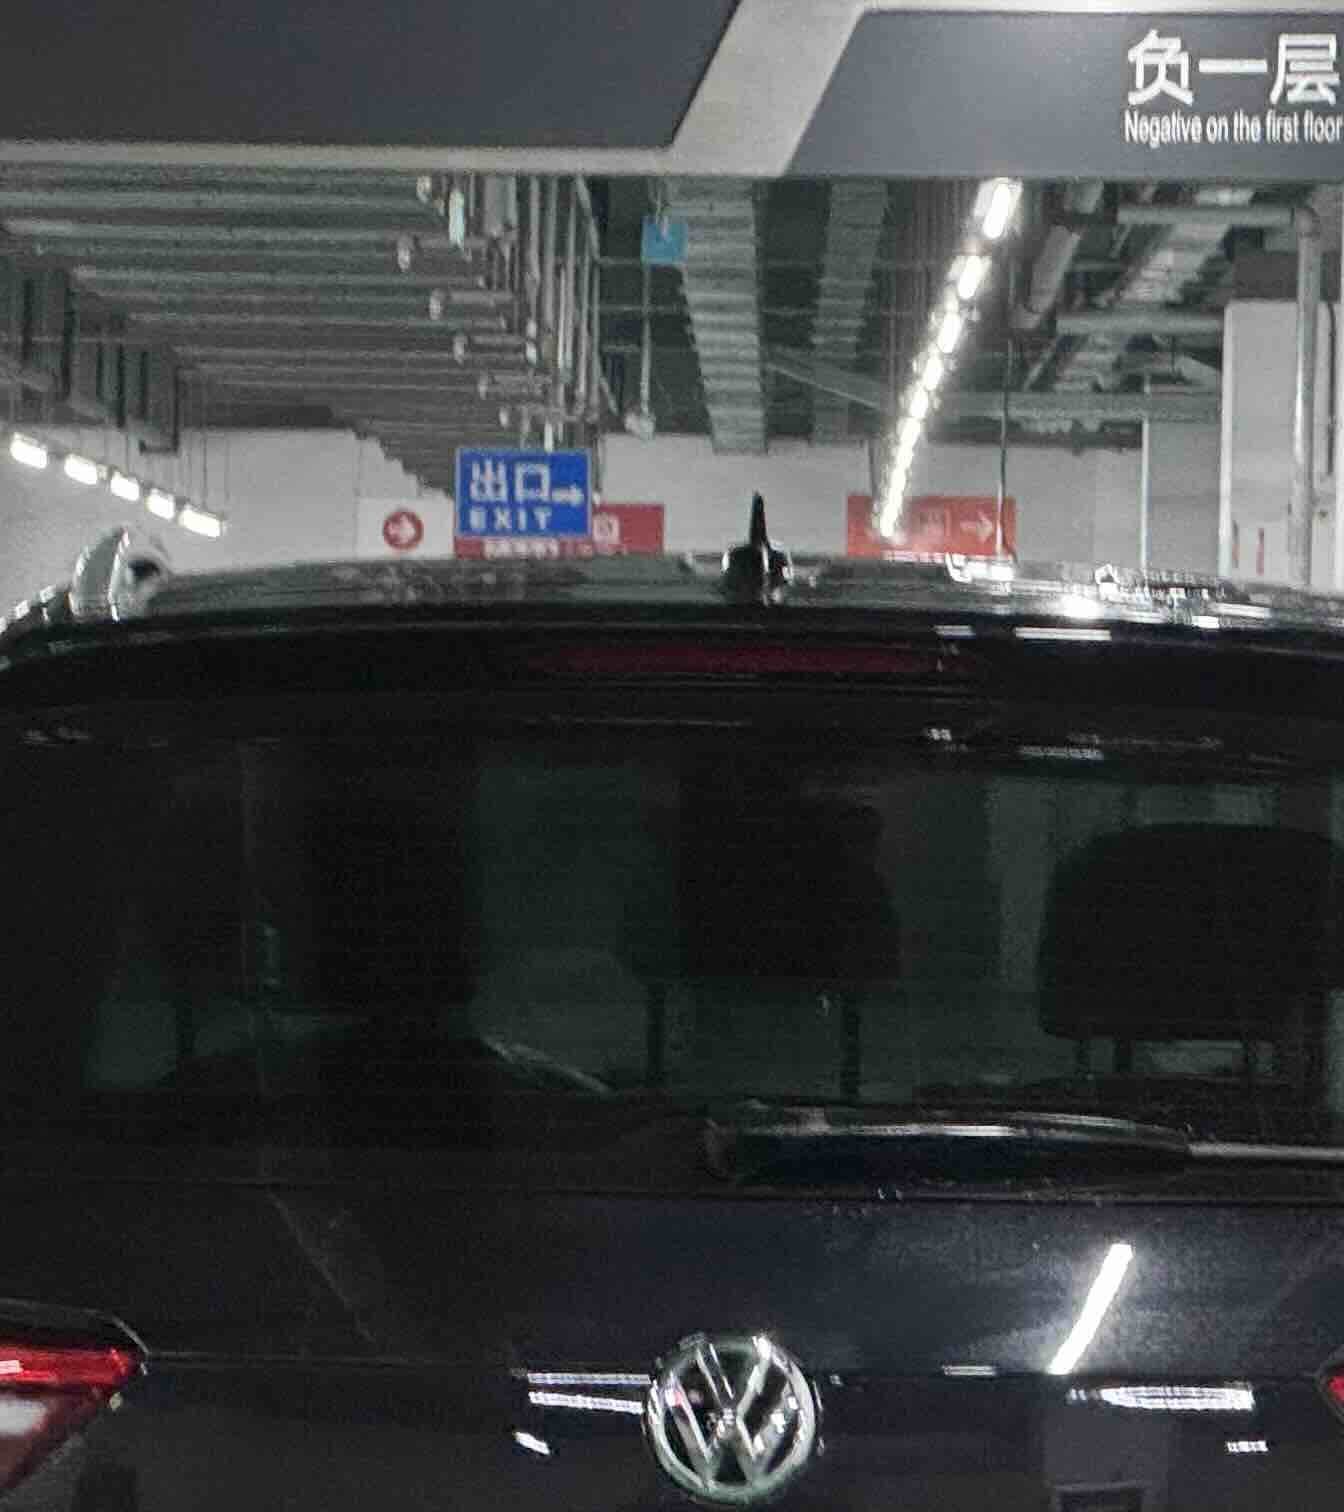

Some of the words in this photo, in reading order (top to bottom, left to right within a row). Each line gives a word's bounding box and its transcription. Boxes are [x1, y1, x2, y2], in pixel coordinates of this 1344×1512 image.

[1127, 29, 1341, 105] 负一层
[1125, 109, 1202, 148] Negative
[1206, 114, 1229, 144] on
[1233, 109, 1262, 144] the
[1265, 109, 1299, 144] first
[1304, 109, 1344, 144] floor
[469, 459, 551, 501] 出口
[469, 506, 552, 530] EXIT
